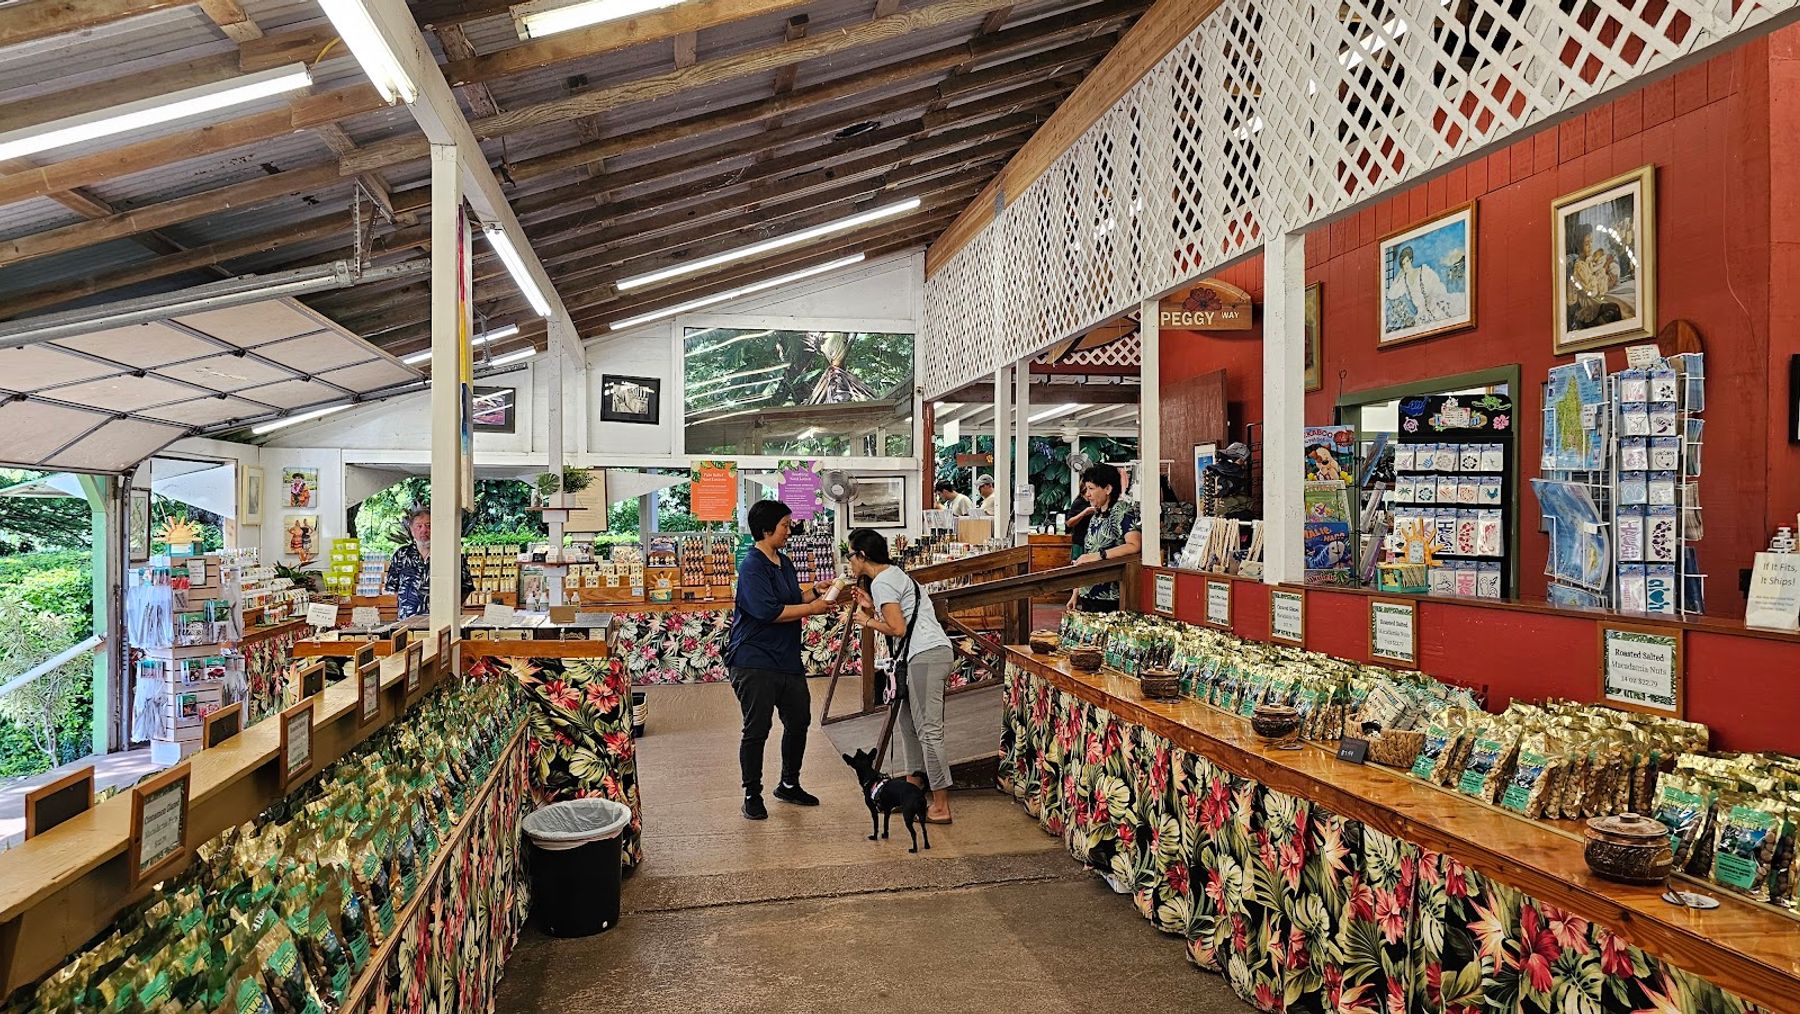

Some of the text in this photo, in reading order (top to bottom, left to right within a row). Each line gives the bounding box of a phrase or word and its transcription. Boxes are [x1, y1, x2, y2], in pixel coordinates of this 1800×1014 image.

[1160, 311, 1239, 326] PEGGY WAY
[1763, 561, 1770, 570] If
[1780, 563, 1798, 573] Fits,
[1769, 577, 1796, 586] Ships!
[1615, 648, 1664, 661] Roasted Salted
[1612, 660, 1666, 675] Macadamia Nuts
